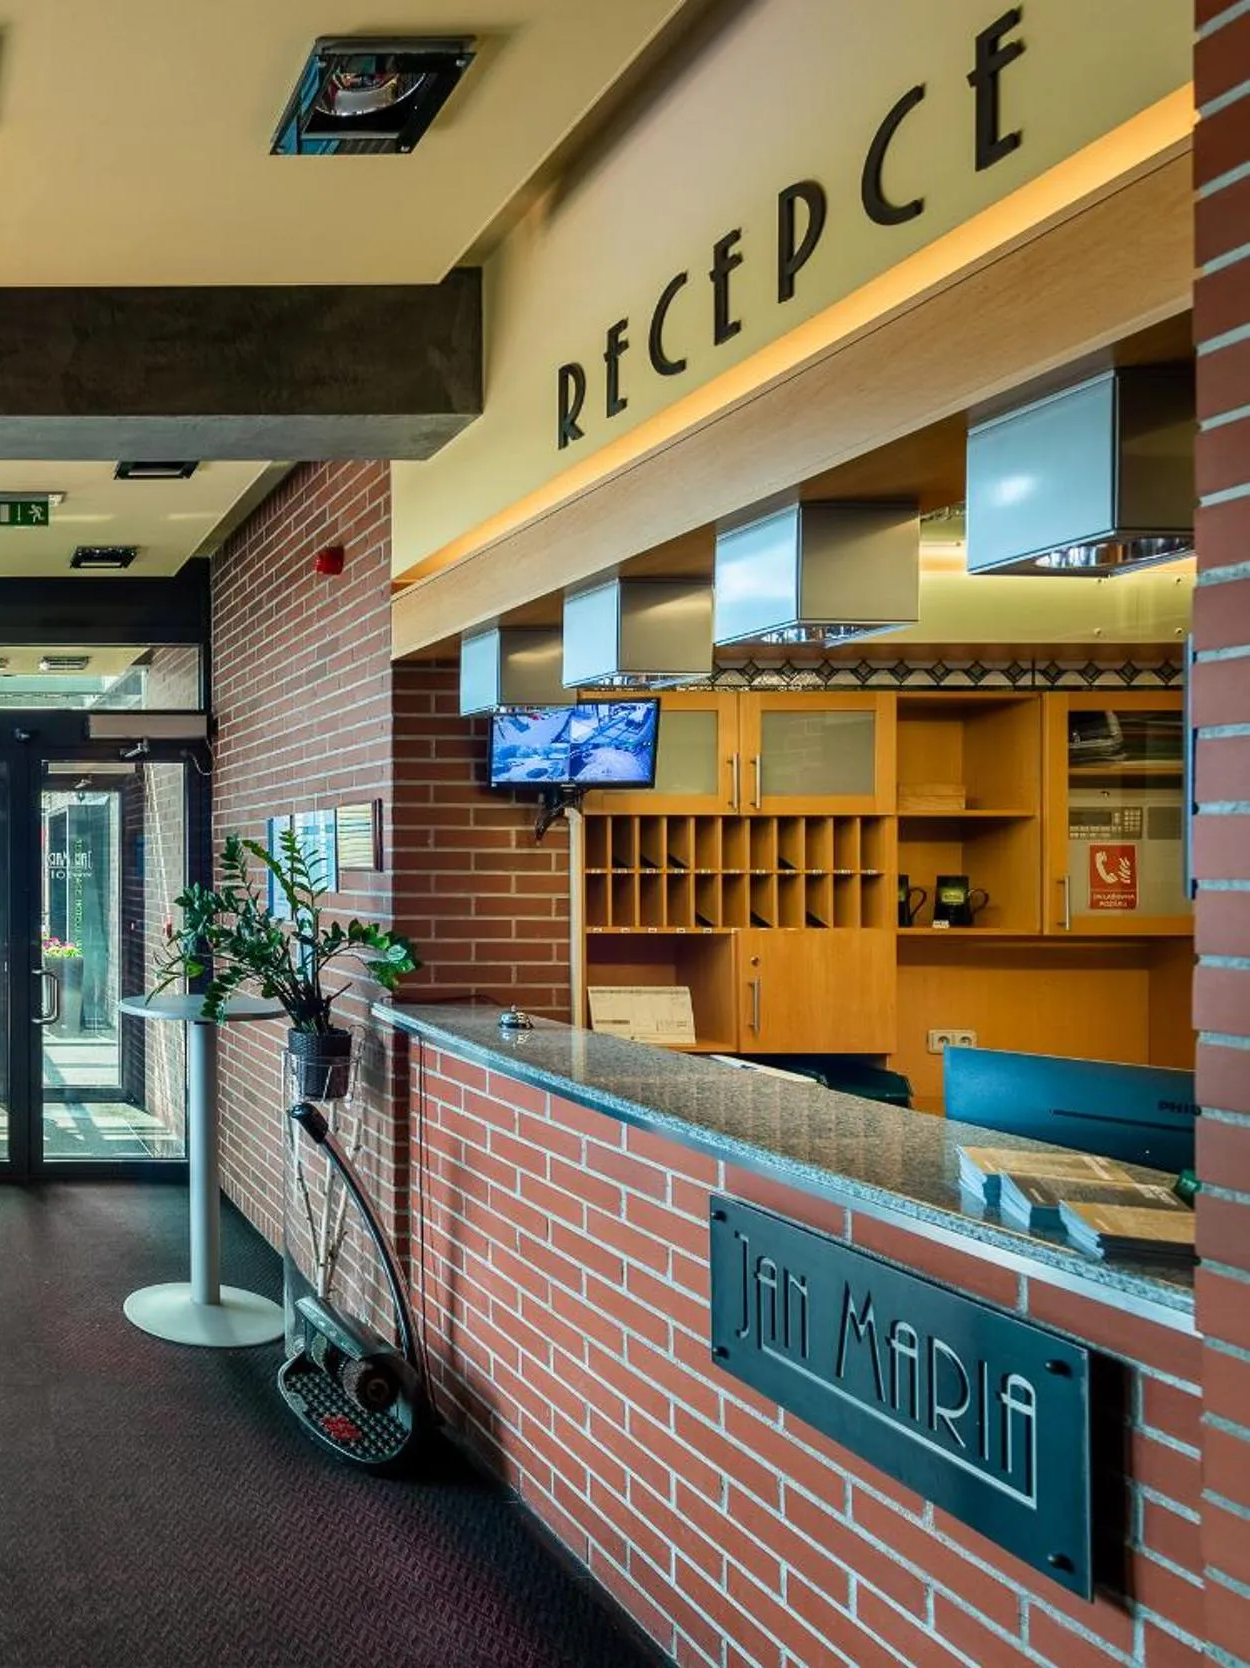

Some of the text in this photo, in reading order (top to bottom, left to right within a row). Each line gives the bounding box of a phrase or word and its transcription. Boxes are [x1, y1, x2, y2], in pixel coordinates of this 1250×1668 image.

[557, 4, 1025, 449] RECEPCE
[734, 1230, 1038, 1510] JAN MARIA
